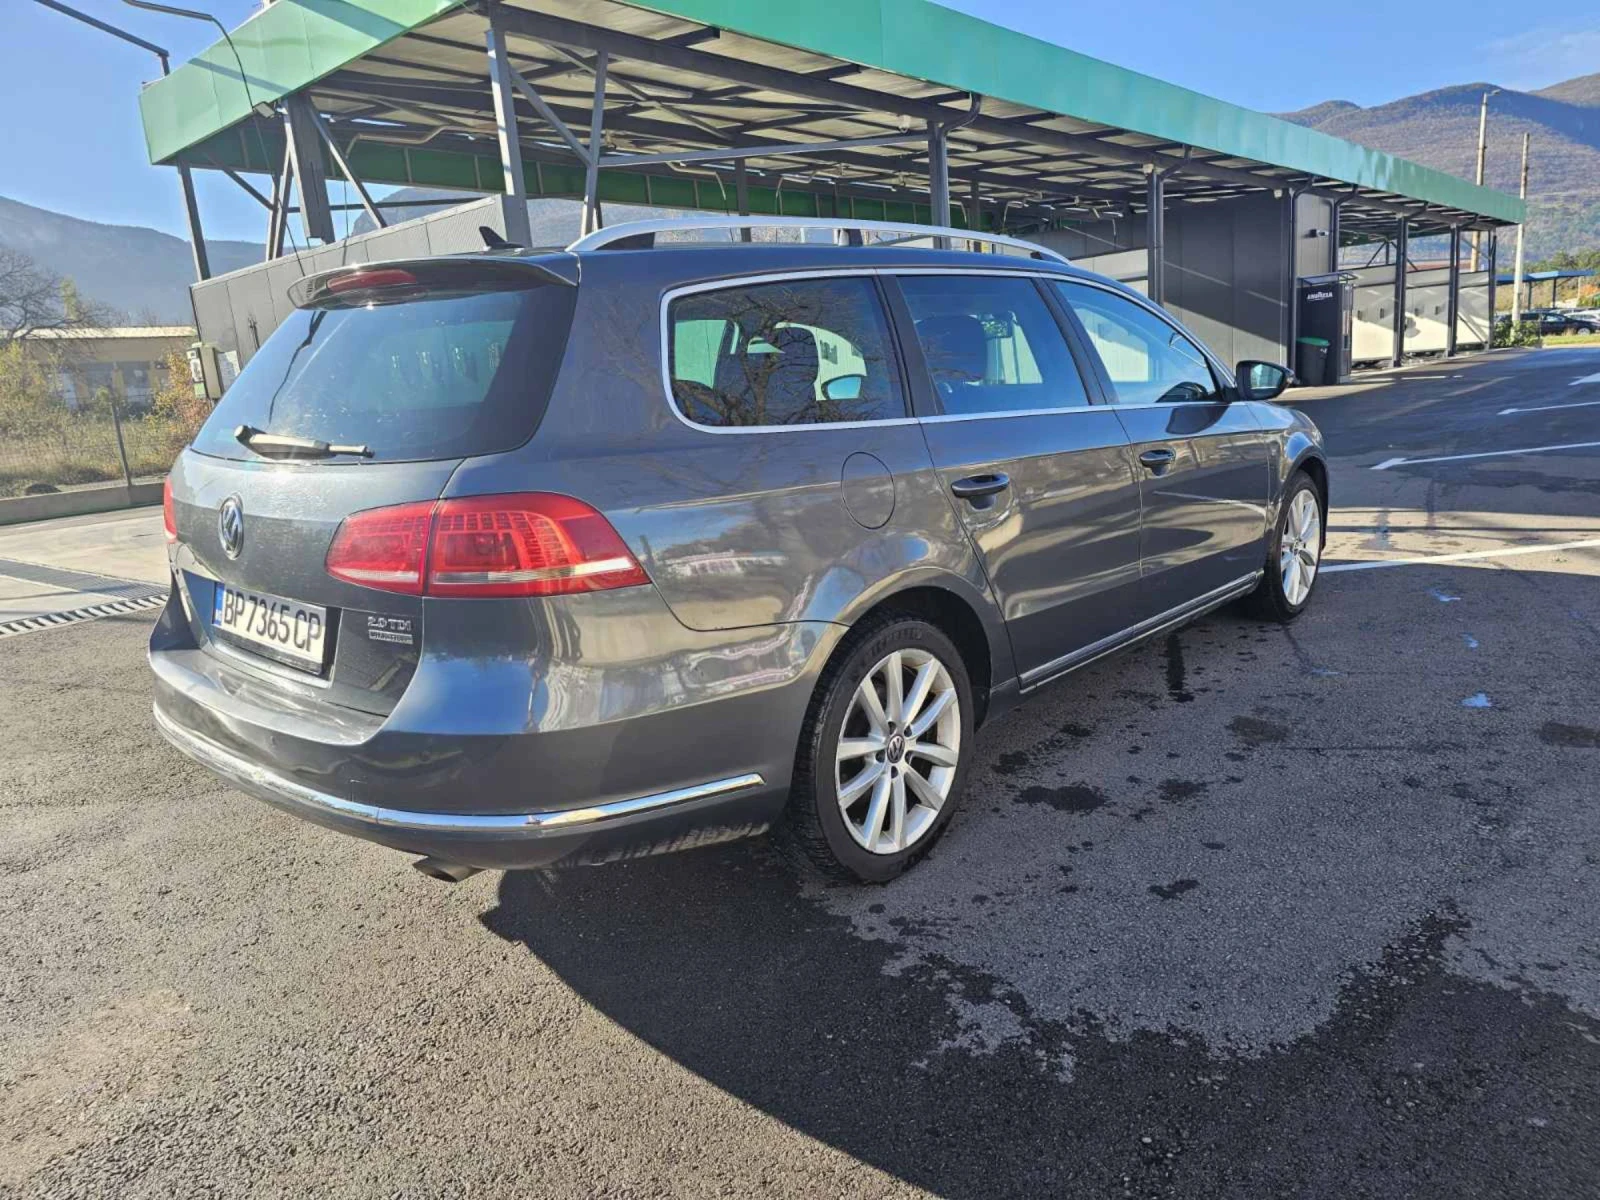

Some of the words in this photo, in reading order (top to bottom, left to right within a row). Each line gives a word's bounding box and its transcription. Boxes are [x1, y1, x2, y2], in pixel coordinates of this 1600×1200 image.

[224, 588, 245, 628] BP
[246, 595, 291, 644] 7365
[294, 609, 322, 653] CP
[388, 618, 411, 631] TDI
